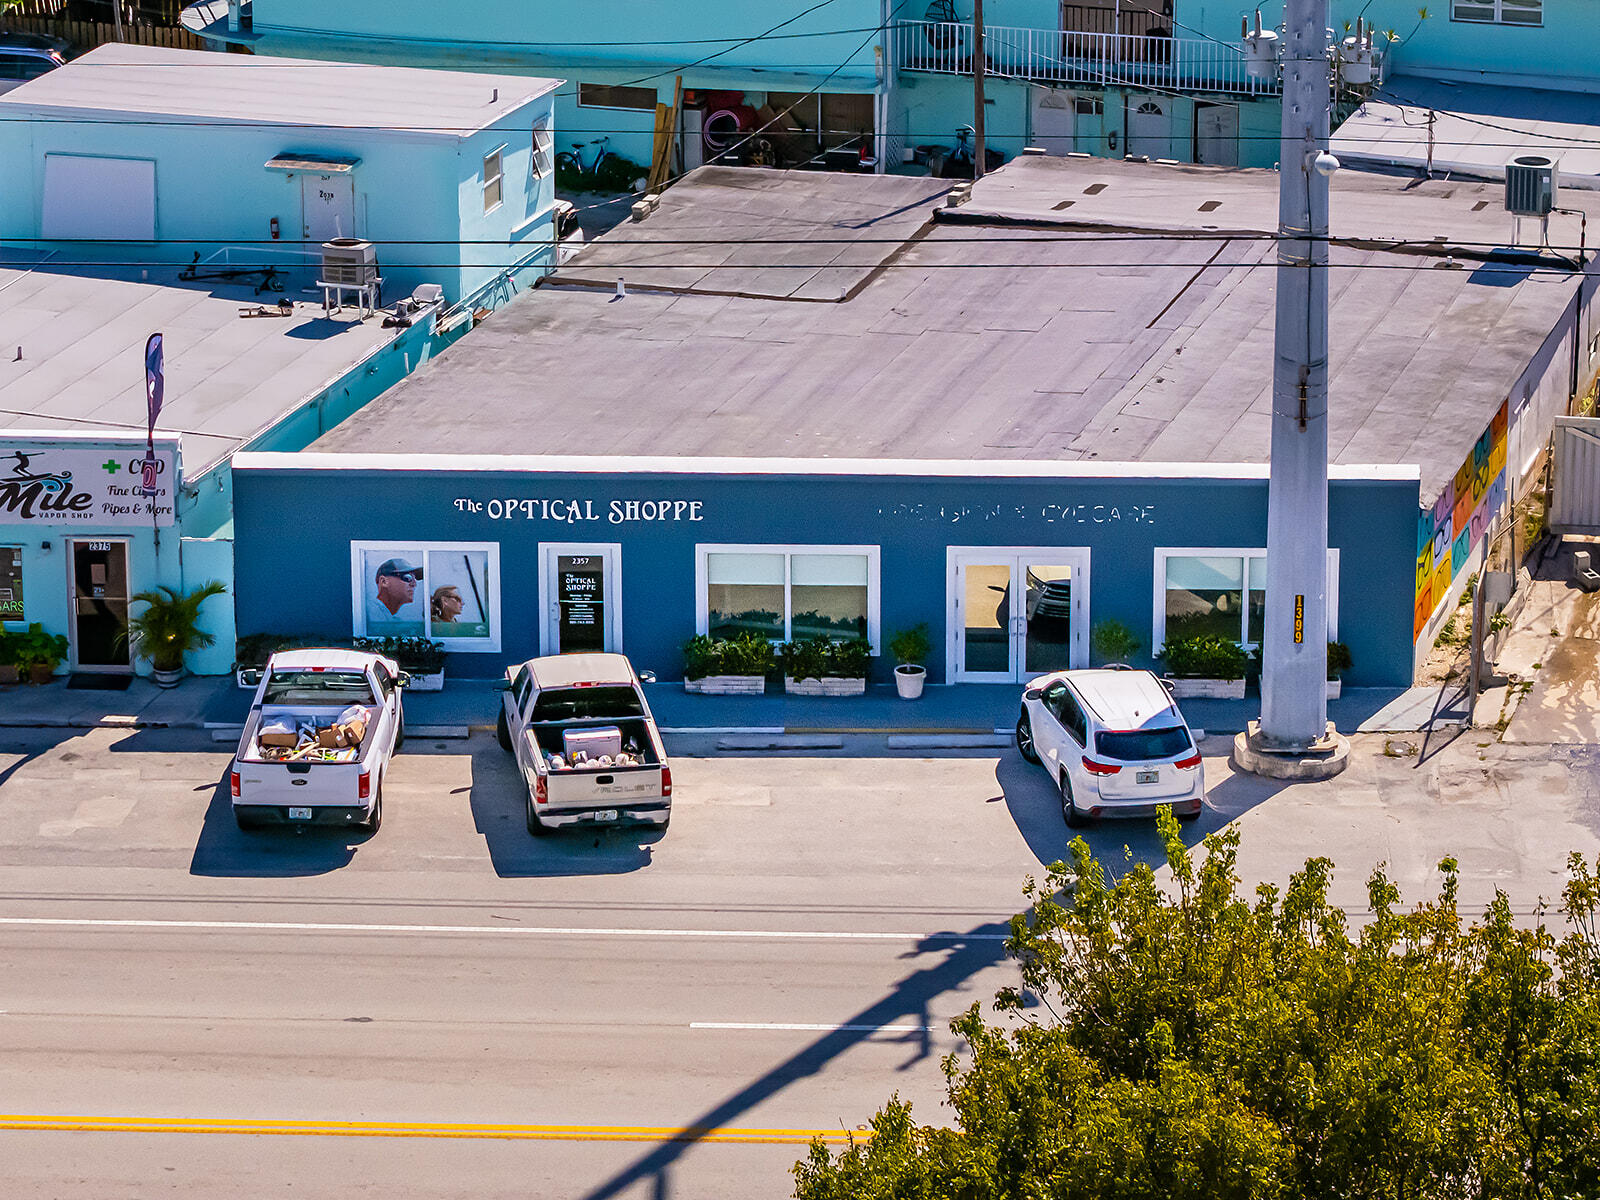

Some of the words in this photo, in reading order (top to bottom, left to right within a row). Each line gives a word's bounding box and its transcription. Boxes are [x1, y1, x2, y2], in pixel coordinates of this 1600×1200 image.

[107, 485, 129, 496] Fine
[131, 485, 166, 499] Cirs
[0, 482, 93, 519] Mile
[101, 502, 130, 516] Pipes
[132, 503, 142, 514] &
[145, 503, 172, 514] More
[453, 498, 483, 513] The
[487, 499, 600, 523] OPTICAL
[608, 500, 704, 524] SHOPPE
[89, 542, 110, 551] 2375
[572, 557, 589, 565] 2357
[0, 600, 24, 612] ARS
[1295, 595, 1303, 643] 1399
